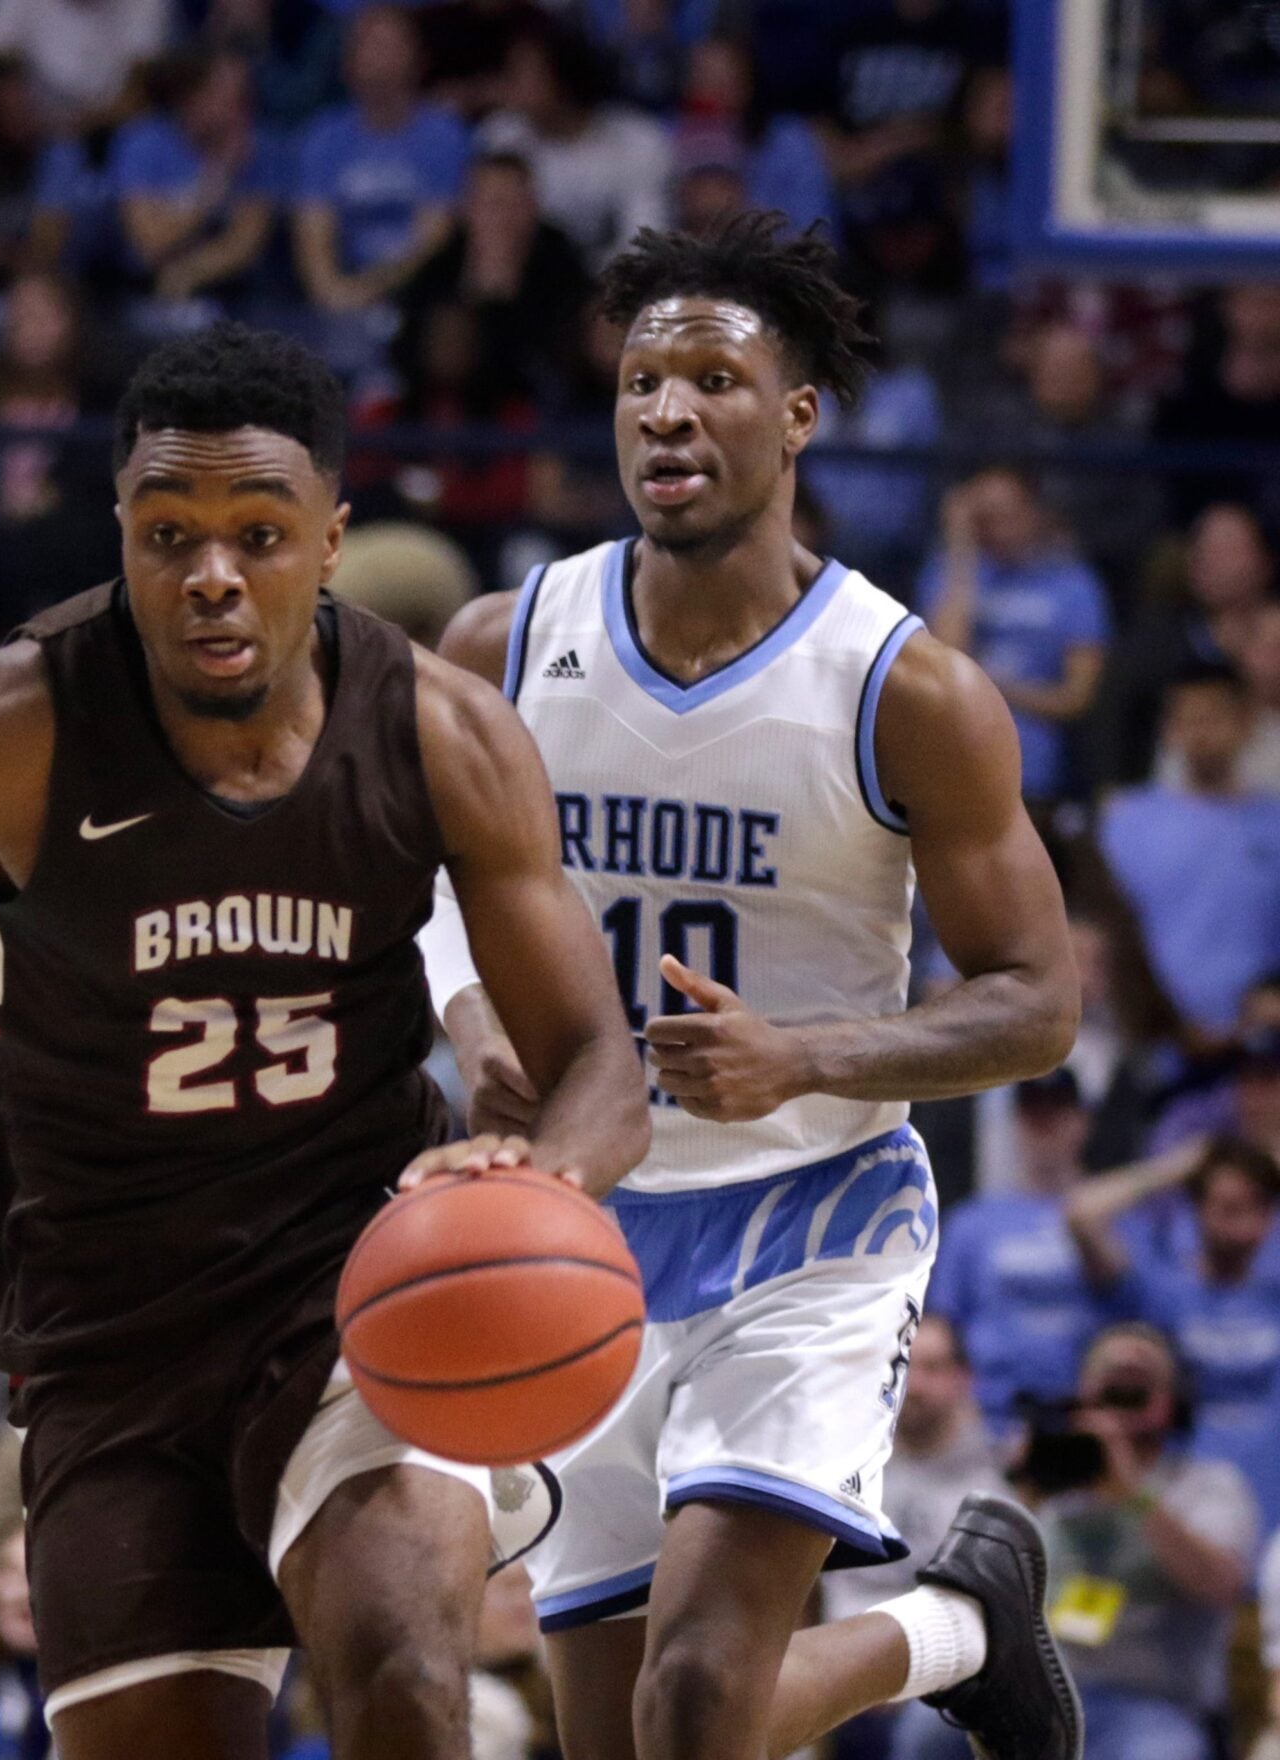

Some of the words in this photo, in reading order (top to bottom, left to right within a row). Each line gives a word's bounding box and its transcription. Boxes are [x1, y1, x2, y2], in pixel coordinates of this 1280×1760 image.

[542, 668, 586, 680] adidas
[555, 790, 780, 888] RHODE
[133, 892, 354, 973] BROWN
[602, 896, 738, 1033] 10
[145, 989, 338, 1115] 25
